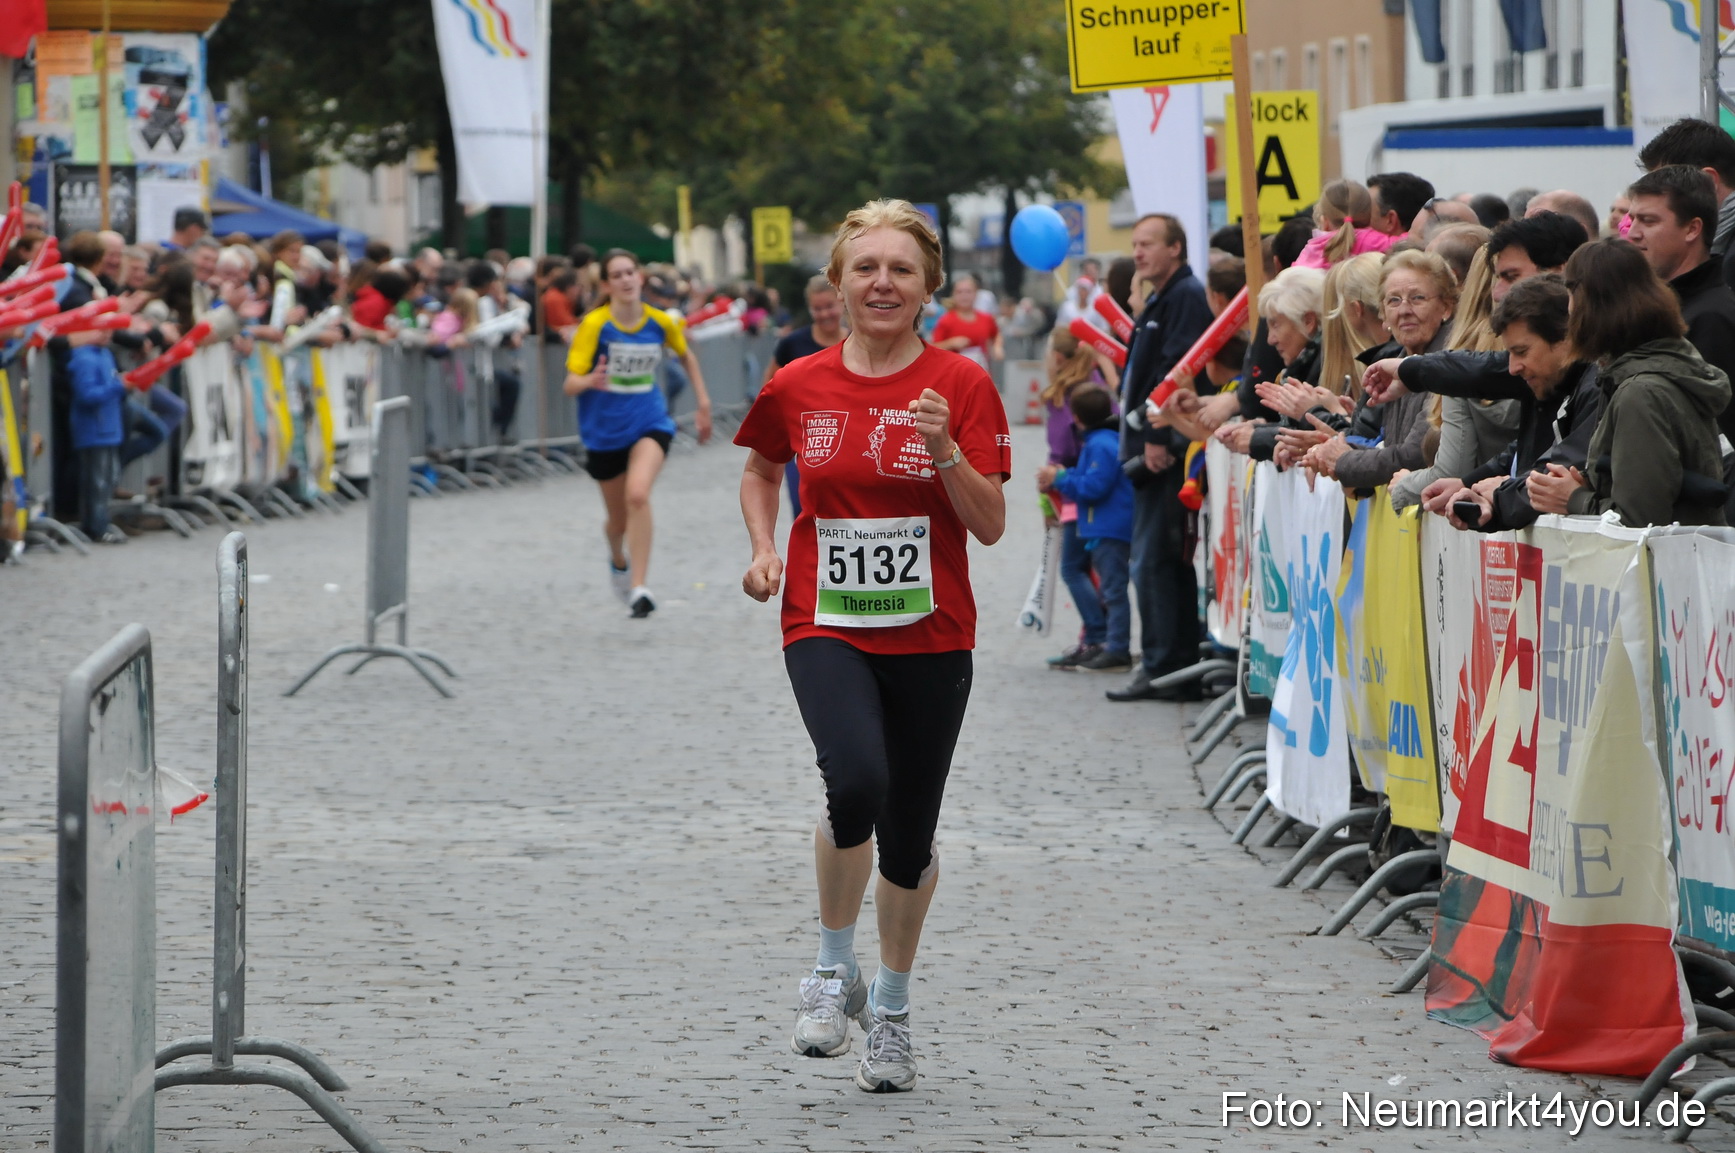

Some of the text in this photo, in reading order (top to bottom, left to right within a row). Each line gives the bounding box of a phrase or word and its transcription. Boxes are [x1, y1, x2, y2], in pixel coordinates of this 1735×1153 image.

[1080, 1, 1230, 29] Schnupper-
[1133, 32, 1180, 56] lauf
[1251, 97, 1309, 122] lock
[1256, 135, 1300, 200] A
[764, 224, 782, 249] D
[868, 408, 916, 419] 11. NEUMA
[807, 418, 838, 428] IMMER
[879, 416, 917, 427] STADTLA
[806, 427, 838, 436] WIEDER
[806, 436, 834, 449] NEU
[805, 449, 831, 458] MARKT
[898, 455, 934, 465] 19.09.201
[819, 528, 908, 540] PARTL Neumarkt
[828, 543, 920, 585] 5132
[841, 595, 905, 613] Theresia
